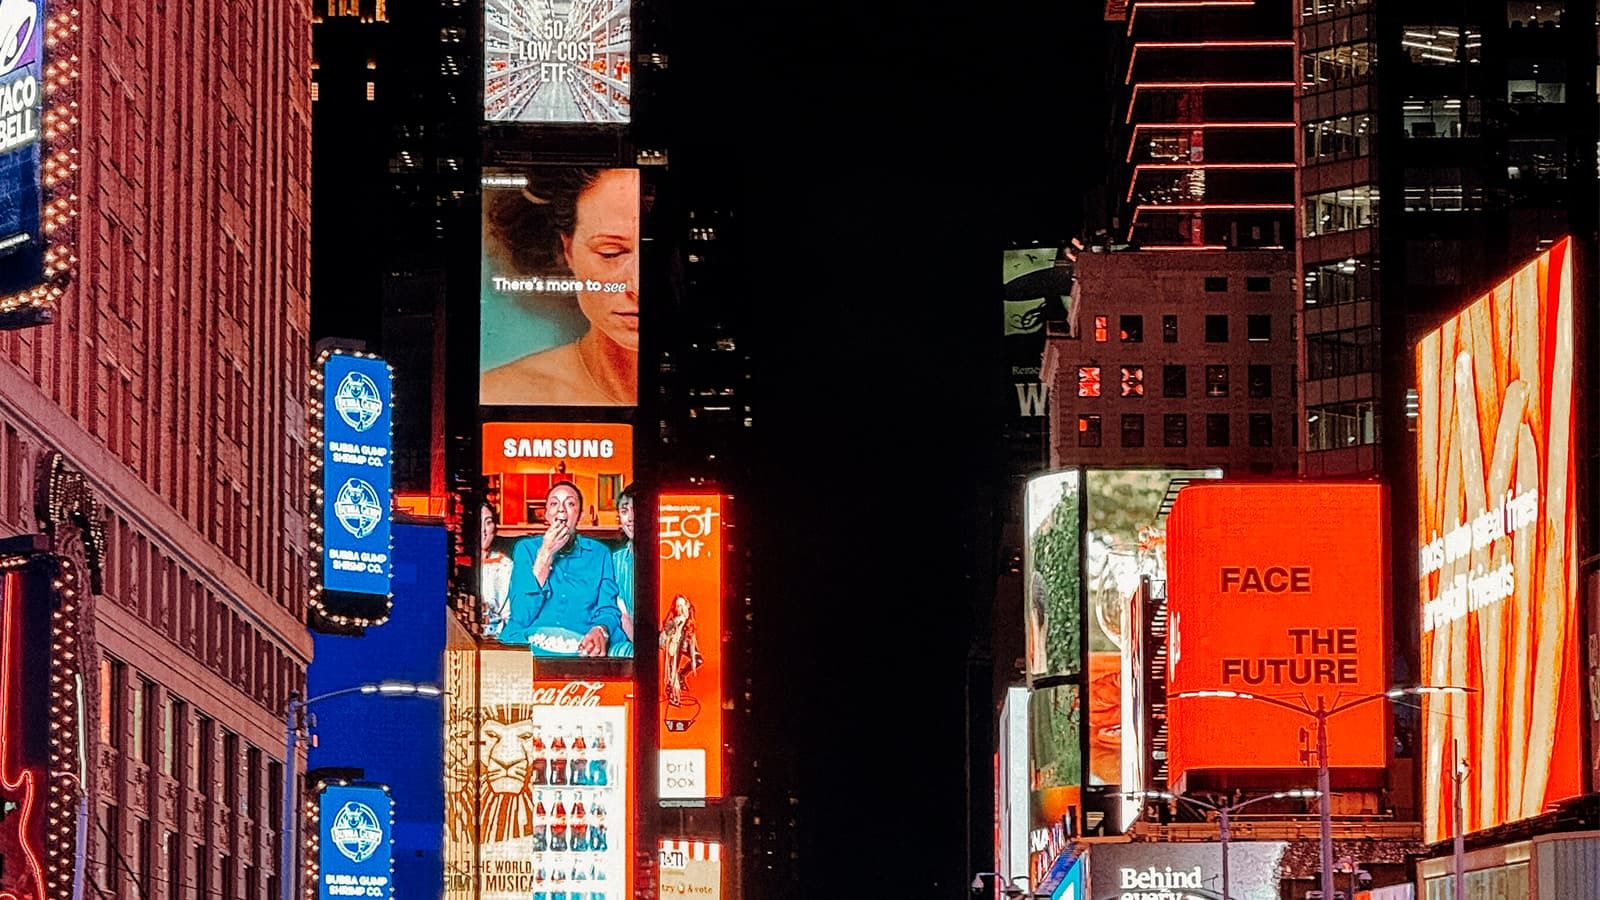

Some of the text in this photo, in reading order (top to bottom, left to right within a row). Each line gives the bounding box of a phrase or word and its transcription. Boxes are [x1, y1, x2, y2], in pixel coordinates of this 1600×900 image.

[519, 41, 597, 61] LOW-COST
[541, 63, 575, 82] ETFs
[0, 109, 37, 150] BELL
[492, 277, 626, 292] There's more to see
[329, 442, 387, 457] BUBBA GUMP
[503, 438, 613, 458] SAMSUNG
[333, 453, 383, 467] SHRIMP CO.
[329, 549, 387, 563] BUBBA GUMP
[332, 560, 383, 574] SHRIMP CO.
[1221, 567, 1311, 593] FACE
[1288, 629, 1357, 654] THE
[1222, 659, 1358, 685] FUTURE
[666, 761, 694, 774] brit
[667, 777, 694, 788] box
[326, 874, 388, 887] BUBBA GUMP
[1120, 866, 1203, 889] Behind
[329, 885, 384, 897] SHRIMP CO.
